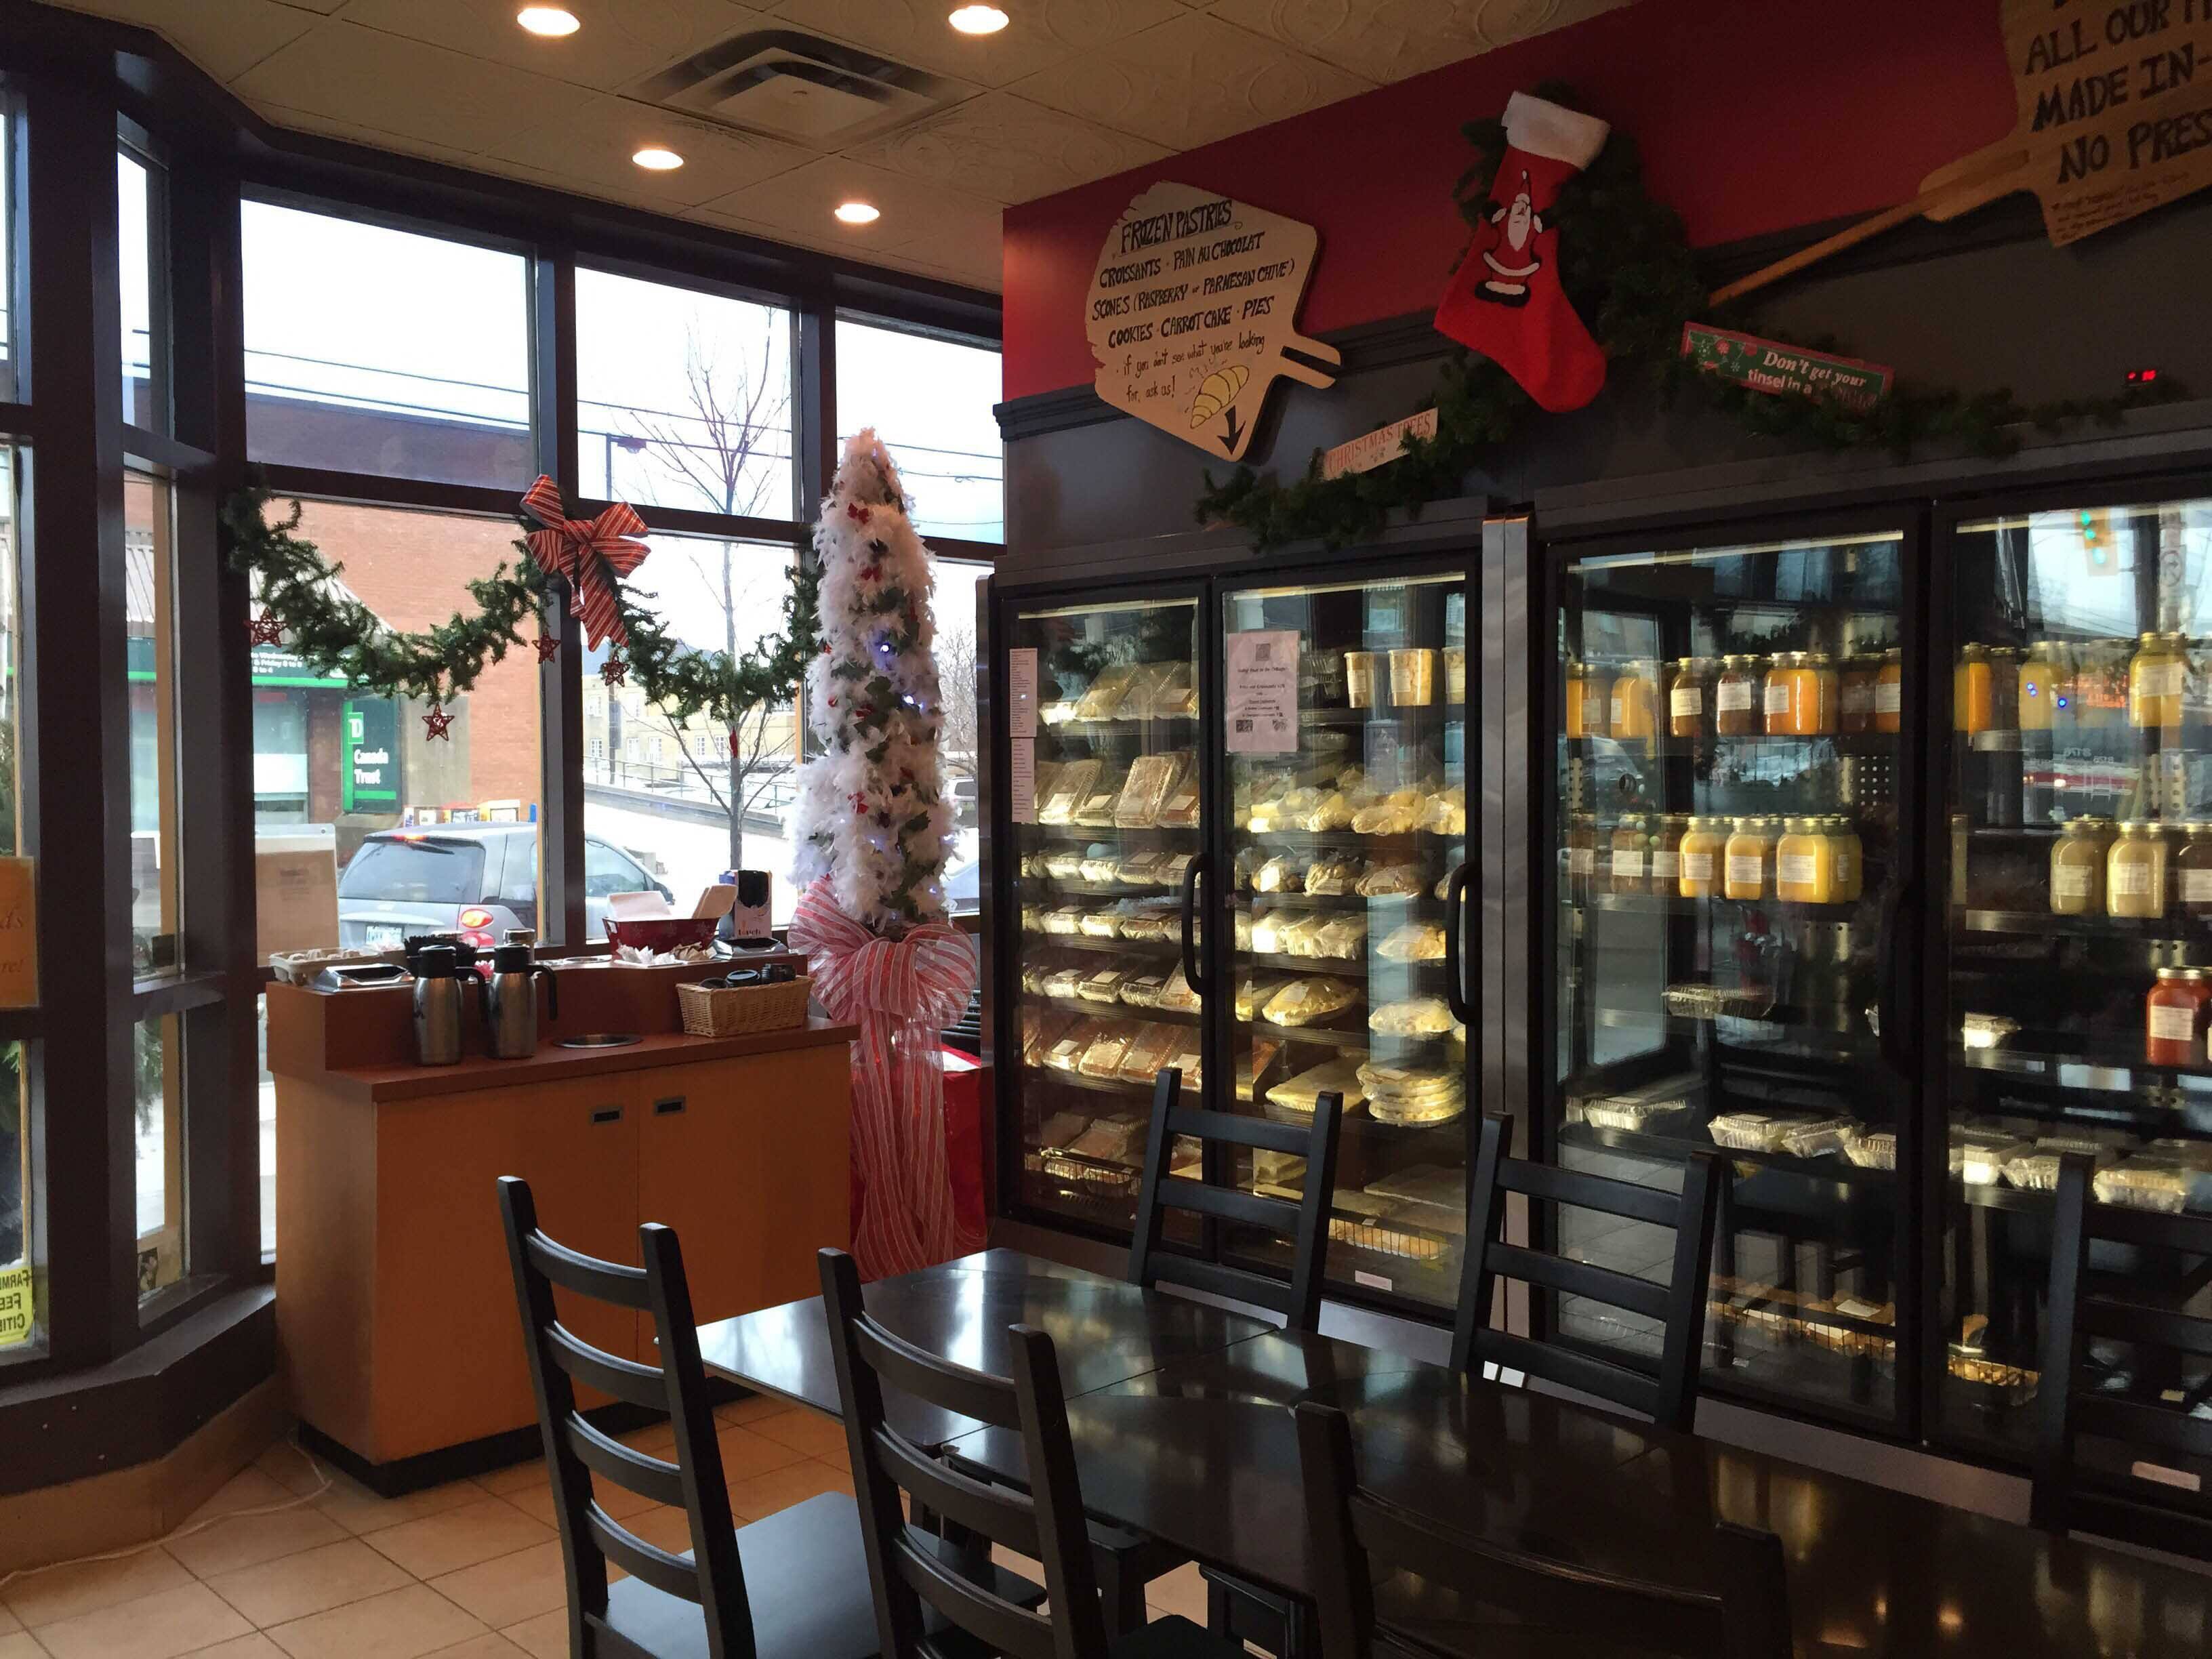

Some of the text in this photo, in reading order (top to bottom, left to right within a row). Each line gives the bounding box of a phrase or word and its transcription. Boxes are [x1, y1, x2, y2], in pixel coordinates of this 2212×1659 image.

[2025, 18, 2098, 75] ALL
[2104, 0, 2169, 45] OUR
[2032, 65, 2129, 132] MADE
[2057, 135, 2110, 184] NO
[1121, 199, 1232, 253] FROZEN PASTRIES
[1100, 230, 1265, 288] CROISSANTS PAIN AU CHOCOLAT
[1092, 295, 1130, 321] SCONES
[1134, 283, 1188, 311] (RASPBERRY
[1203, 270, 1256, 295] PARMESAN
[1108, 295, 1275, 348] COOKIES CARROT CAKE PIES
[1135, 361, 1149, 378] you
[1187, 340, 1207, 359] what
[1239, 331, 1265, 354] looking
[1762, 350, 1867, 387] Don't get your
[1146, 381, 1159, 398] ask
[1748, 369, 1786, 389] tinsel
[1788, 375, 1801, 391] in
[1328, 427, 1393, 473] CHRISTMAS
[354, 747, 388, 764] Canada
[354, 769, 381, 784] Trust
